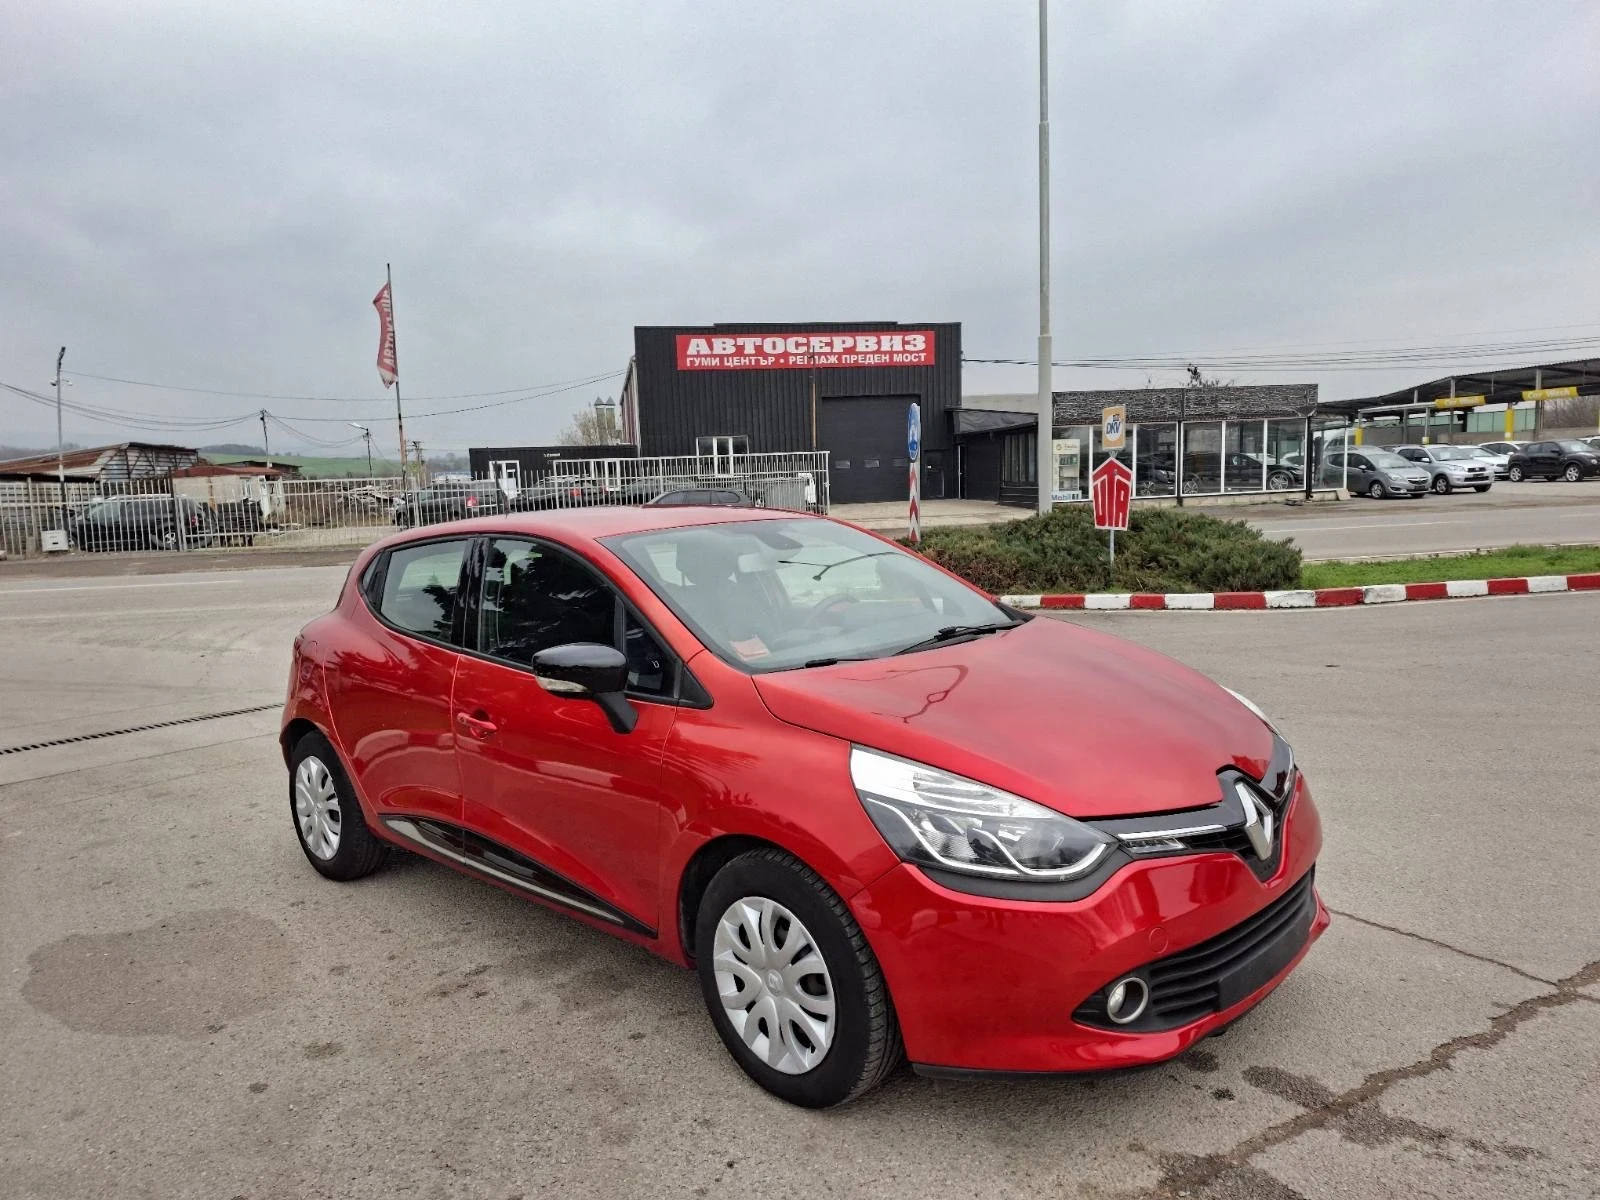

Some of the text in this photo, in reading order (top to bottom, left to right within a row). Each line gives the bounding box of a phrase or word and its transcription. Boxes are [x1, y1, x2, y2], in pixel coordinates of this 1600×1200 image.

[686, 334, 927, 355] АВТОСЕРВИЗ
[686, 357, 720, 367] ГУМИ
[723, 356, 776, 367] ЦЕНТЪР
[842, 354, 890, 364] ПРЕДЕН
[893, 352, 927, 363] МОСТ
[1106, 421, 1121, 434] DKV
